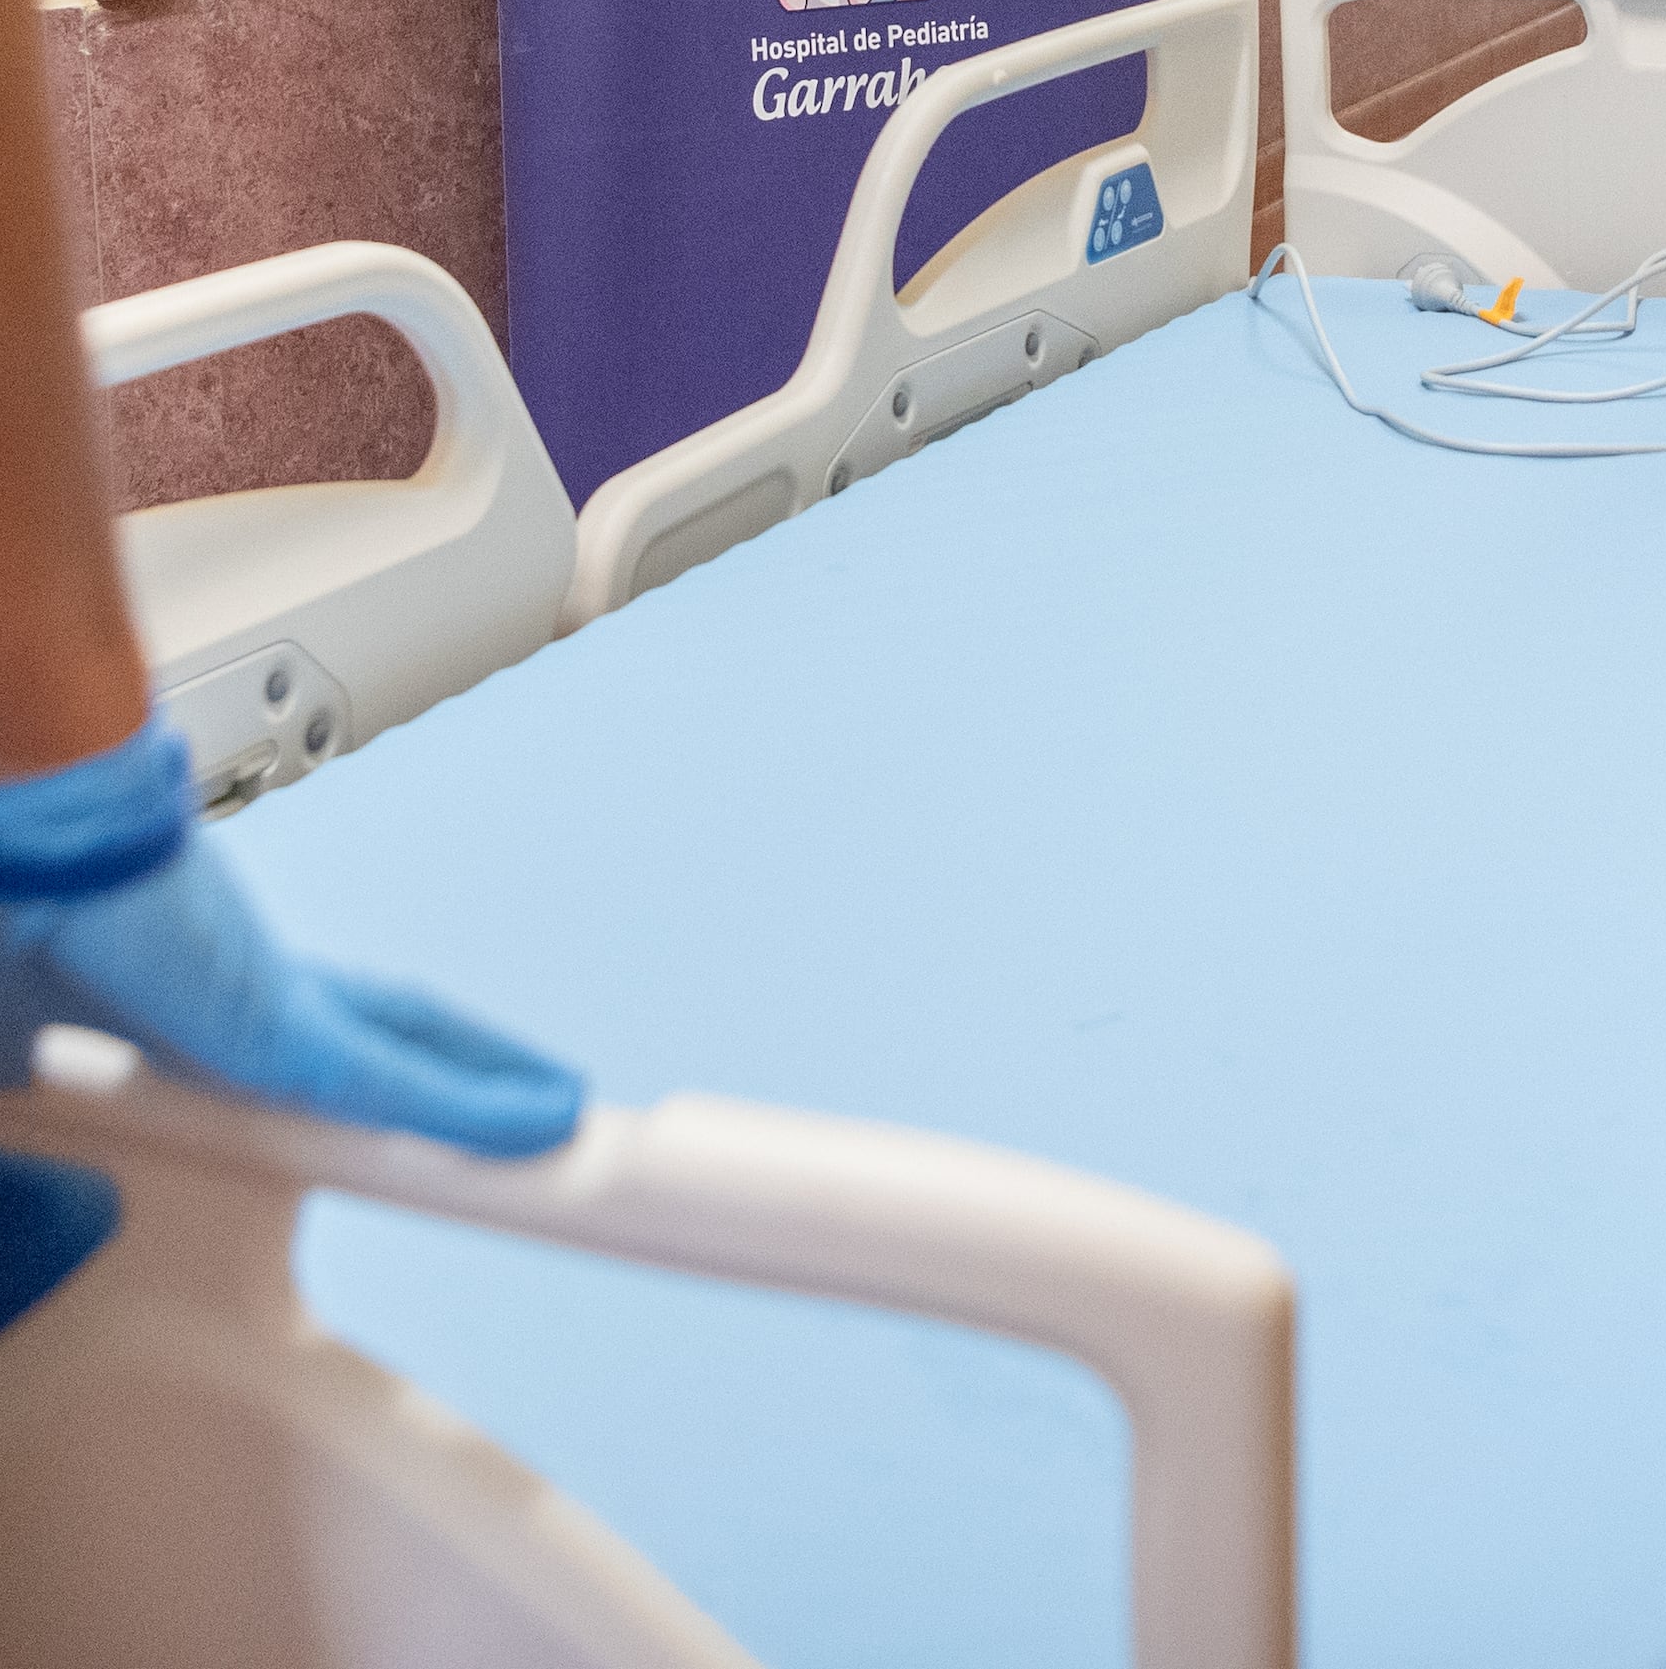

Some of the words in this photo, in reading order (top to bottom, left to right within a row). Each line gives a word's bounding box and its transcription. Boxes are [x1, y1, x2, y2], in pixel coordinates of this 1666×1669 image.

[751, 29, 848, 63] Hospital
[853, 27, 881, 52] de
[887, 15, 989, 48] Pediatría
[752, 57, 927, 121] Garrah
